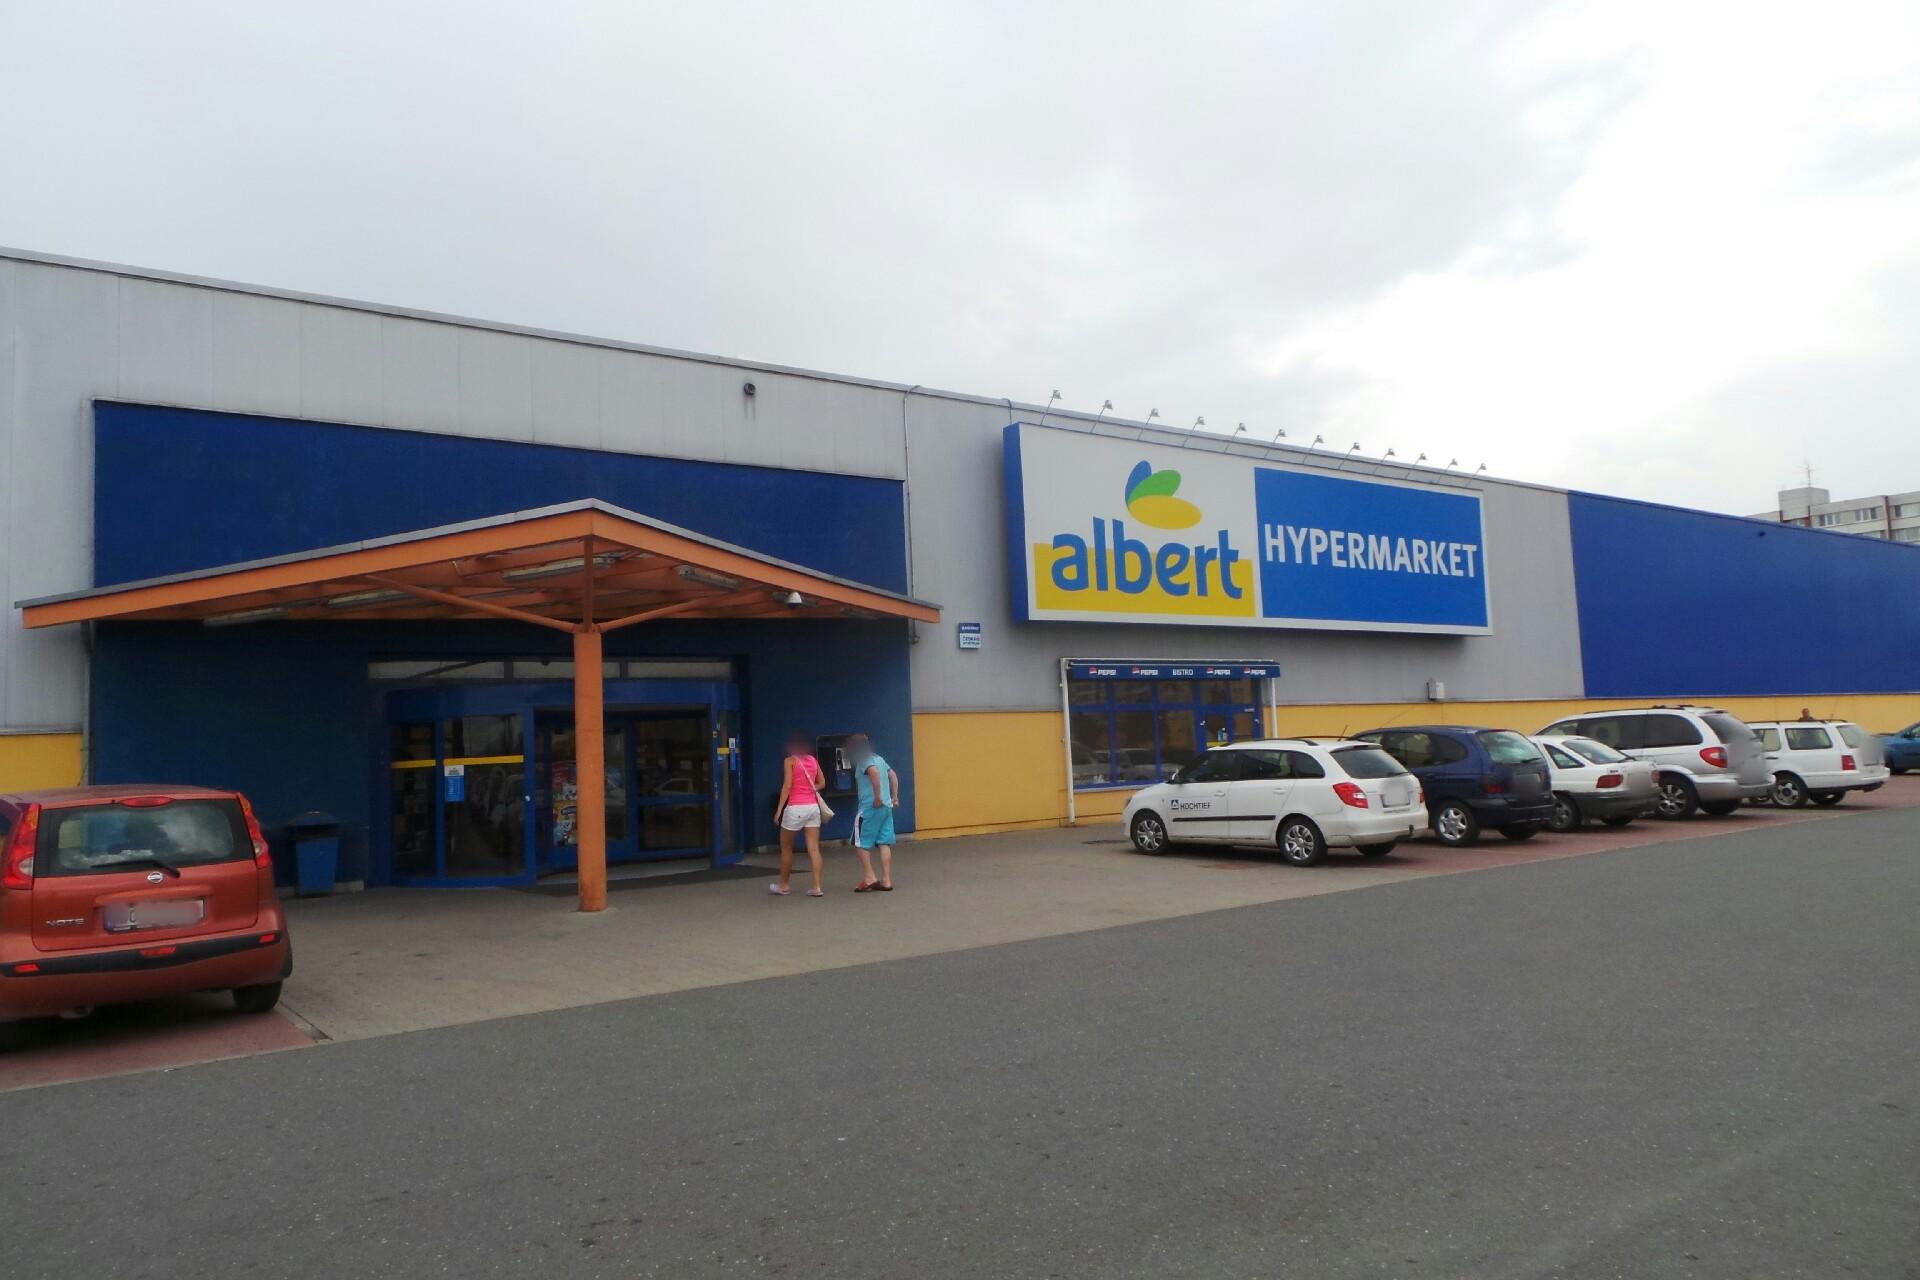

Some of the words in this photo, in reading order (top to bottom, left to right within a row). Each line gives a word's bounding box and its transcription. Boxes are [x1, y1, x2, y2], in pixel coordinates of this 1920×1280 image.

[1051, 516, 1243, 600] albert
[1264, 523, 1477, 578] HYPERMARKET
[1172, 668, 1194, 676] BISTRO
[1180, 802, 1211, 810] HOCHTIEF
